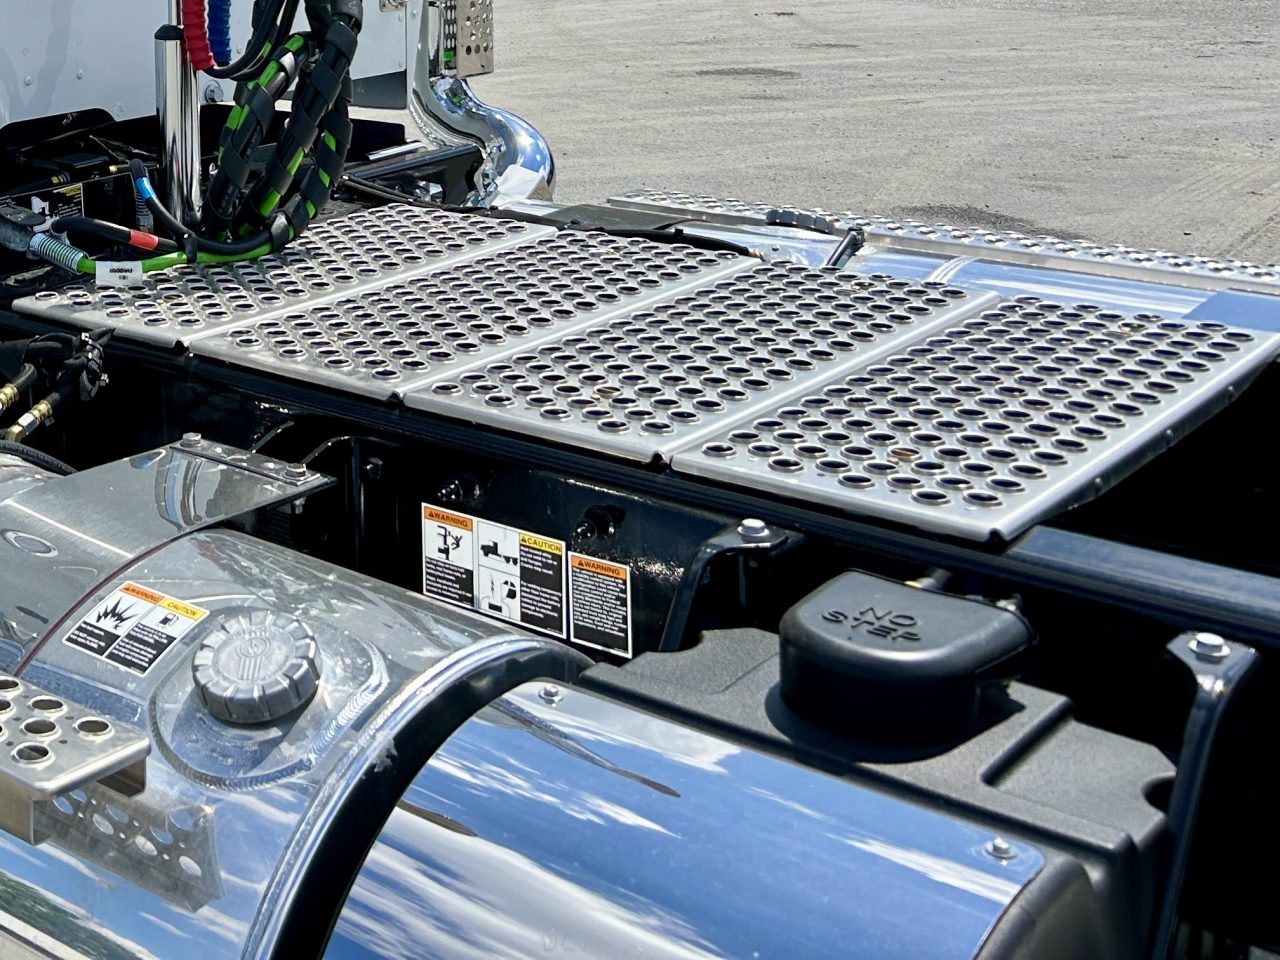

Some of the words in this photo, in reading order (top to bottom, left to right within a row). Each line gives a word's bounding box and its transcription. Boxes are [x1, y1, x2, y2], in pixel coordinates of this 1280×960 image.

[434, 510, 468, 527] WARNING
[527, 538, 562, 552] CAUTION
[584, 560, 620, 576] WARNING
[167, 602, 198, 616] CAUTION
[860, 607, 917, 627] NO
[821, 609, 922, 641] STEP
